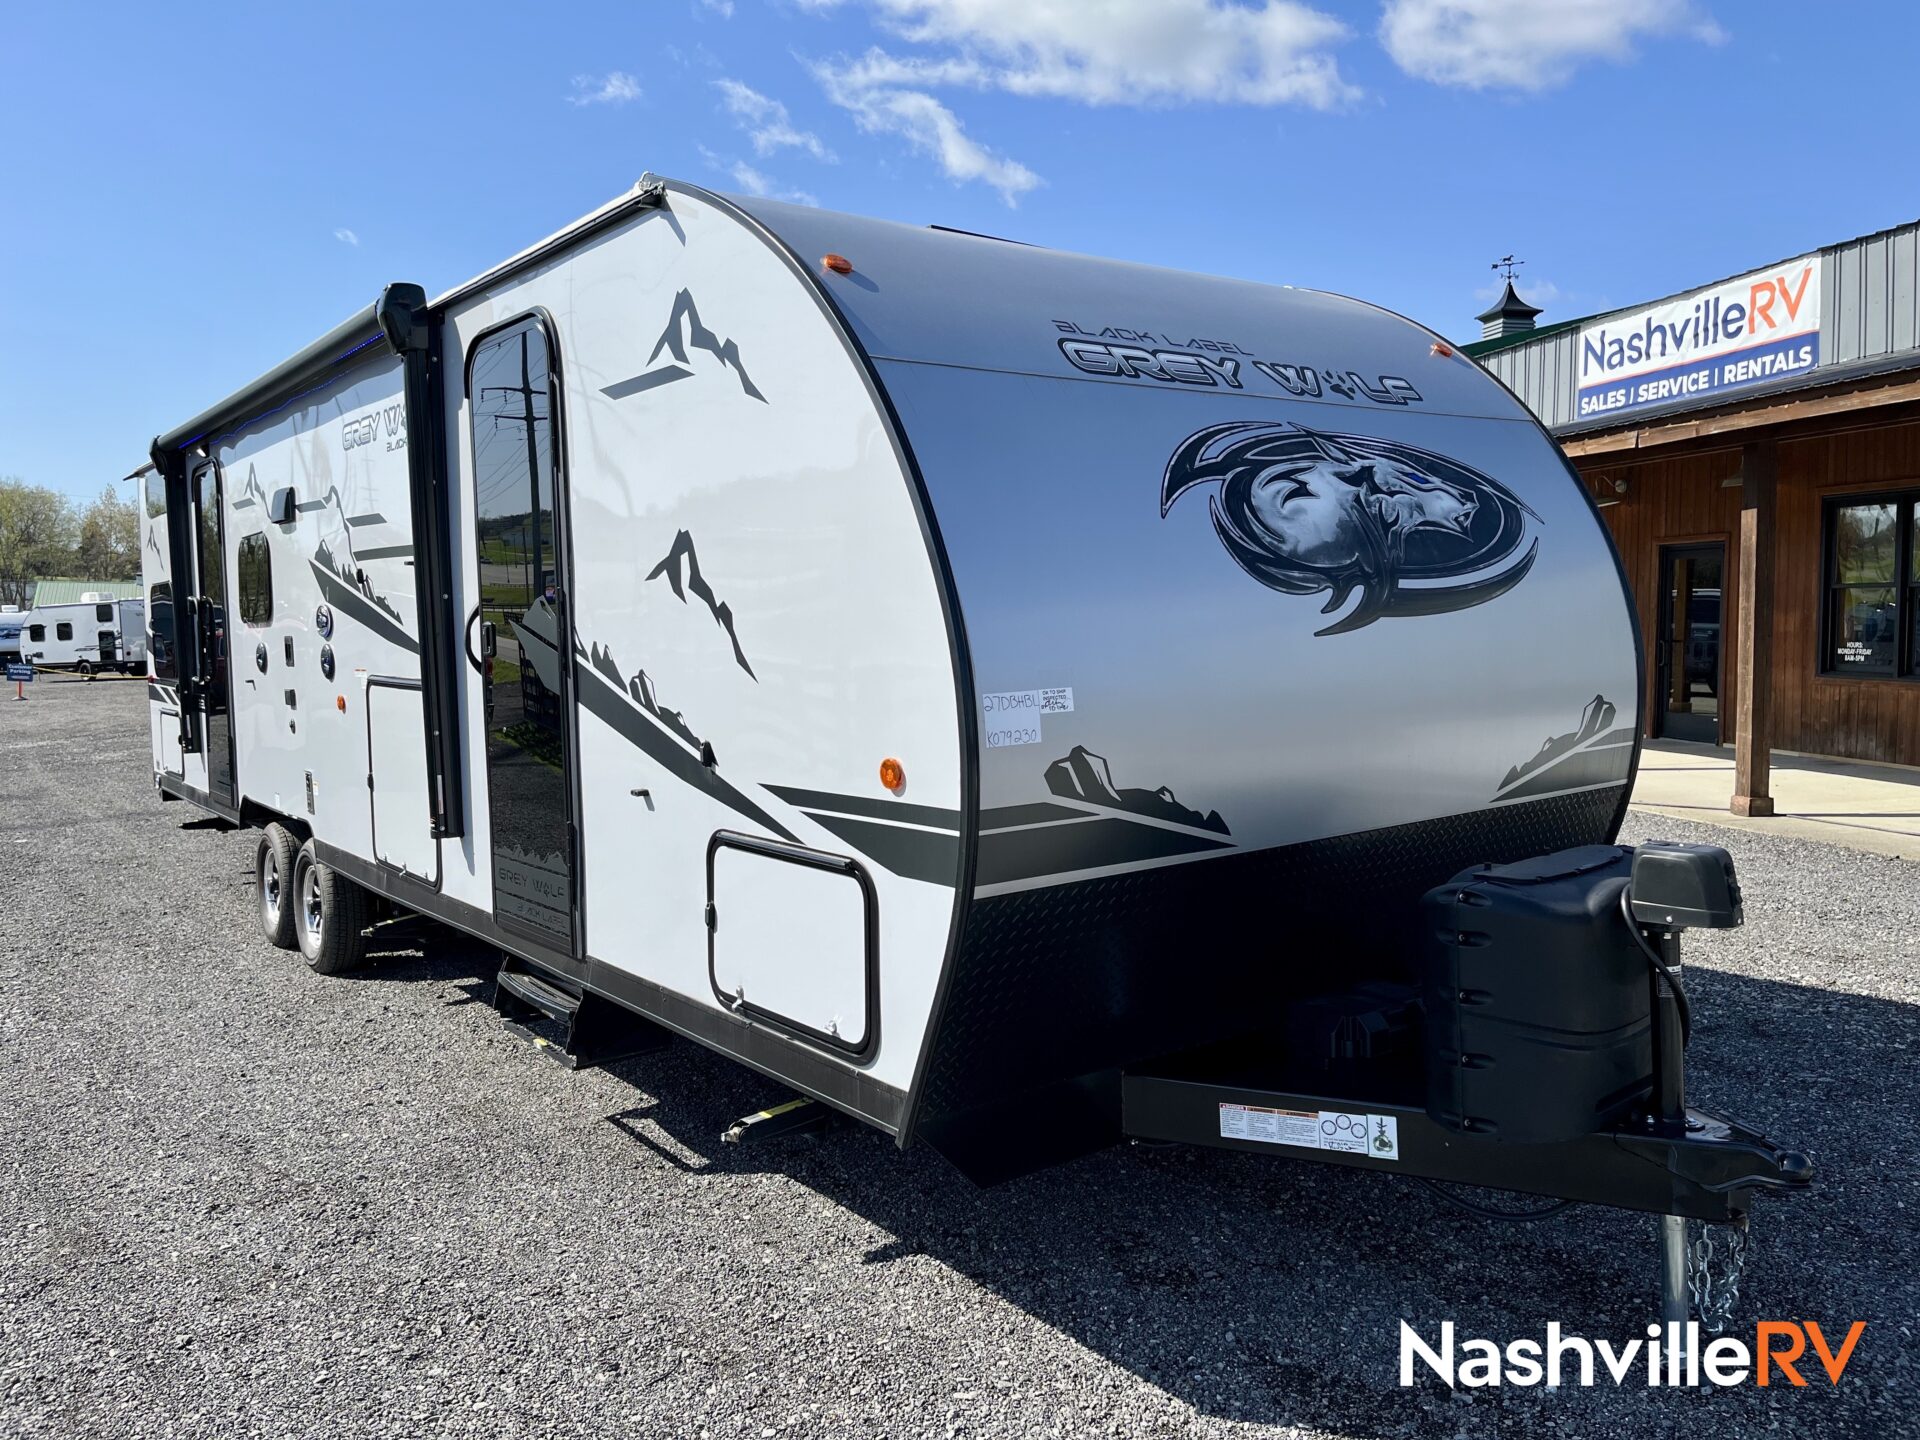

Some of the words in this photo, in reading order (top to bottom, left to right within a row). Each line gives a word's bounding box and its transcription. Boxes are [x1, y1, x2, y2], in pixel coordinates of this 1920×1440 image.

[1051, 319, 1158, 344] BLACK
[1161, 333, 1256, 357] LABEL
[1057, 337, 1244, 390] GREY
[1581, 389, 1626, 415] SALES
[1637, 370, 1709, 402] SERVICE
[1724, 346, 1812, 383] RENTALS
[343, 412, 380, 450] GREY
[987, 729, 1037, 748] K079230
